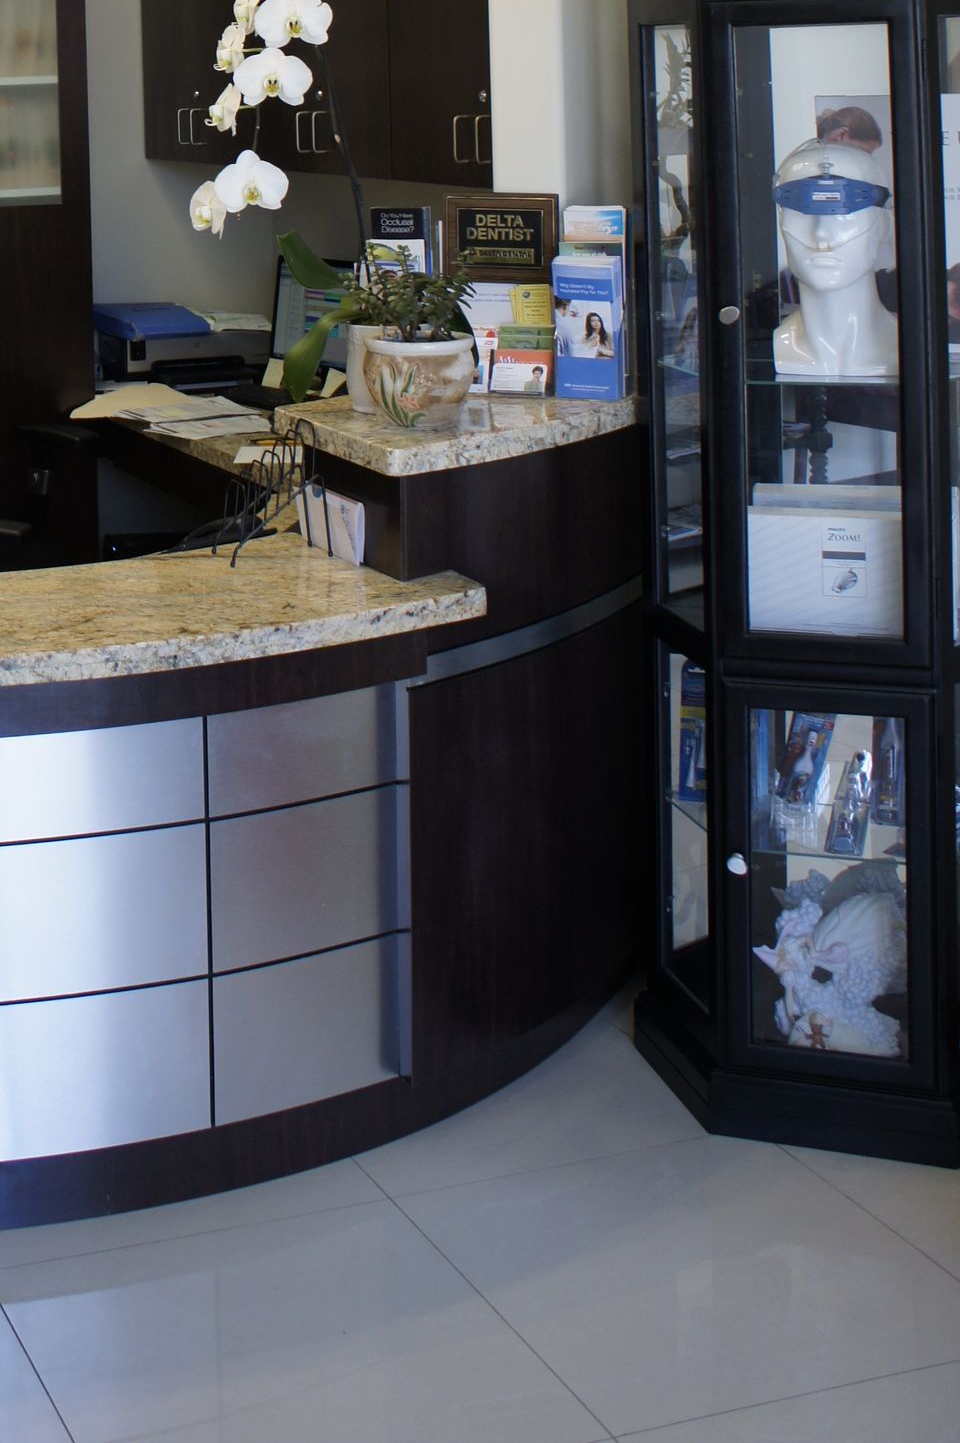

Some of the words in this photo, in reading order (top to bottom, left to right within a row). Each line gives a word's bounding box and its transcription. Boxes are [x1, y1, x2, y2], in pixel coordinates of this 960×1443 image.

[380, 218, 414, 226] Occlusal
[475, 214, 524, 227] DELTA
[466, 227, 534, 241] DENTIST
[479, 249, 501, 257] DELTA
[502, 250, 531, 258] DENTAL
